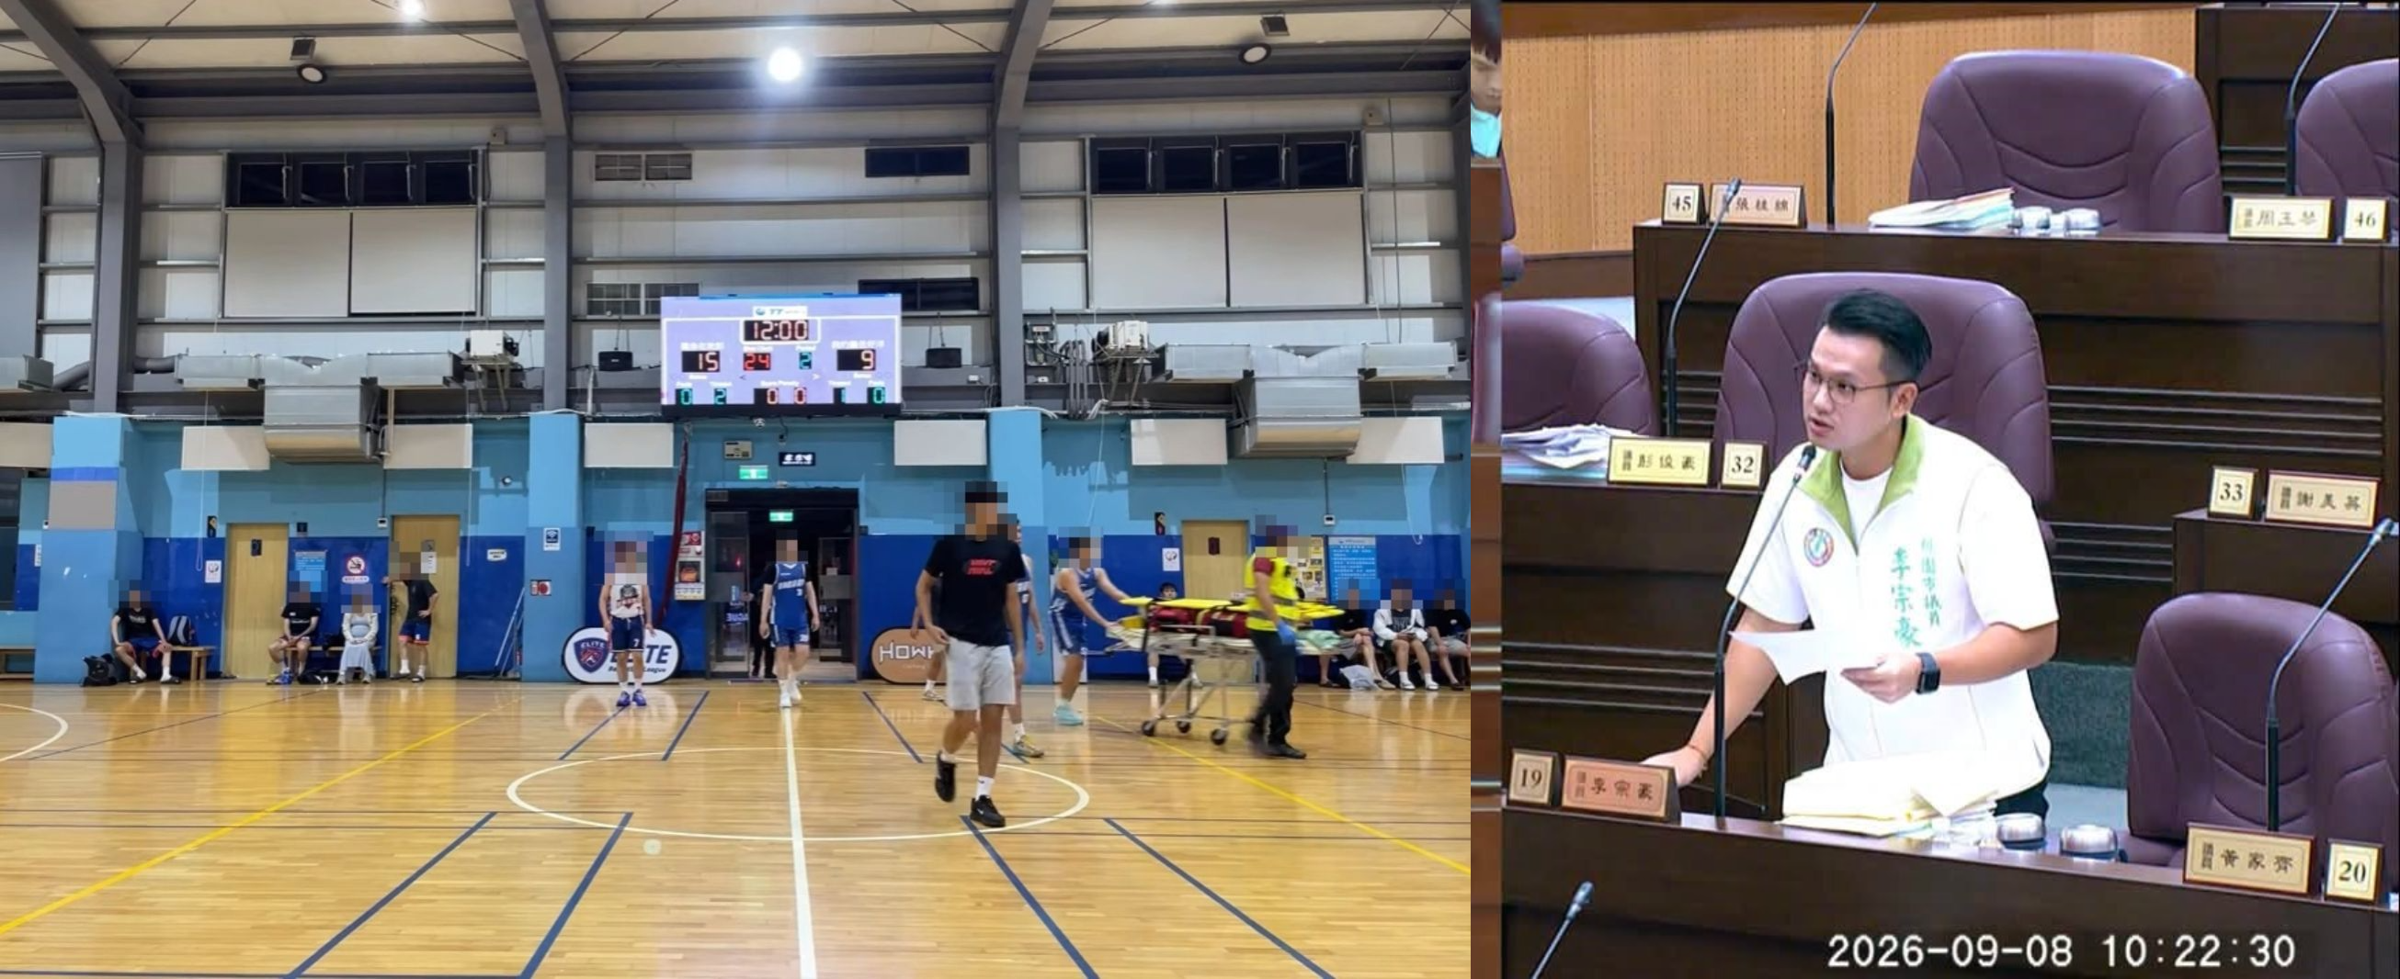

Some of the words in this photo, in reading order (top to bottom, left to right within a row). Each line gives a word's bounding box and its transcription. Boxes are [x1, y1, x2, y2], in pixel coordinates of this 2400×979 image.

[1671, 196, 1692, 212] 45
[2354, 210, 2377, 229] 46
[753, 319, 808, 341] 12:00
[698, 351, 719, 372] 15
[744, 352, 770, 371] 24
[799, 352, 812, 370] 2
[860, 349, 874, 370] 9
[680, 387, 693, 406] 0
[713, 387, 727, 405] 2
[766, 387, 779, 405] 0
[794, 387, 807, 405] 0
[872, 386, 886, 405] 0
[1731, 456, 1755, 474] 32
[2219, 482, 2244, 502] 33
[1520, 768, 1543, 789] 19
[2338, 860, 2367, 884] 20
